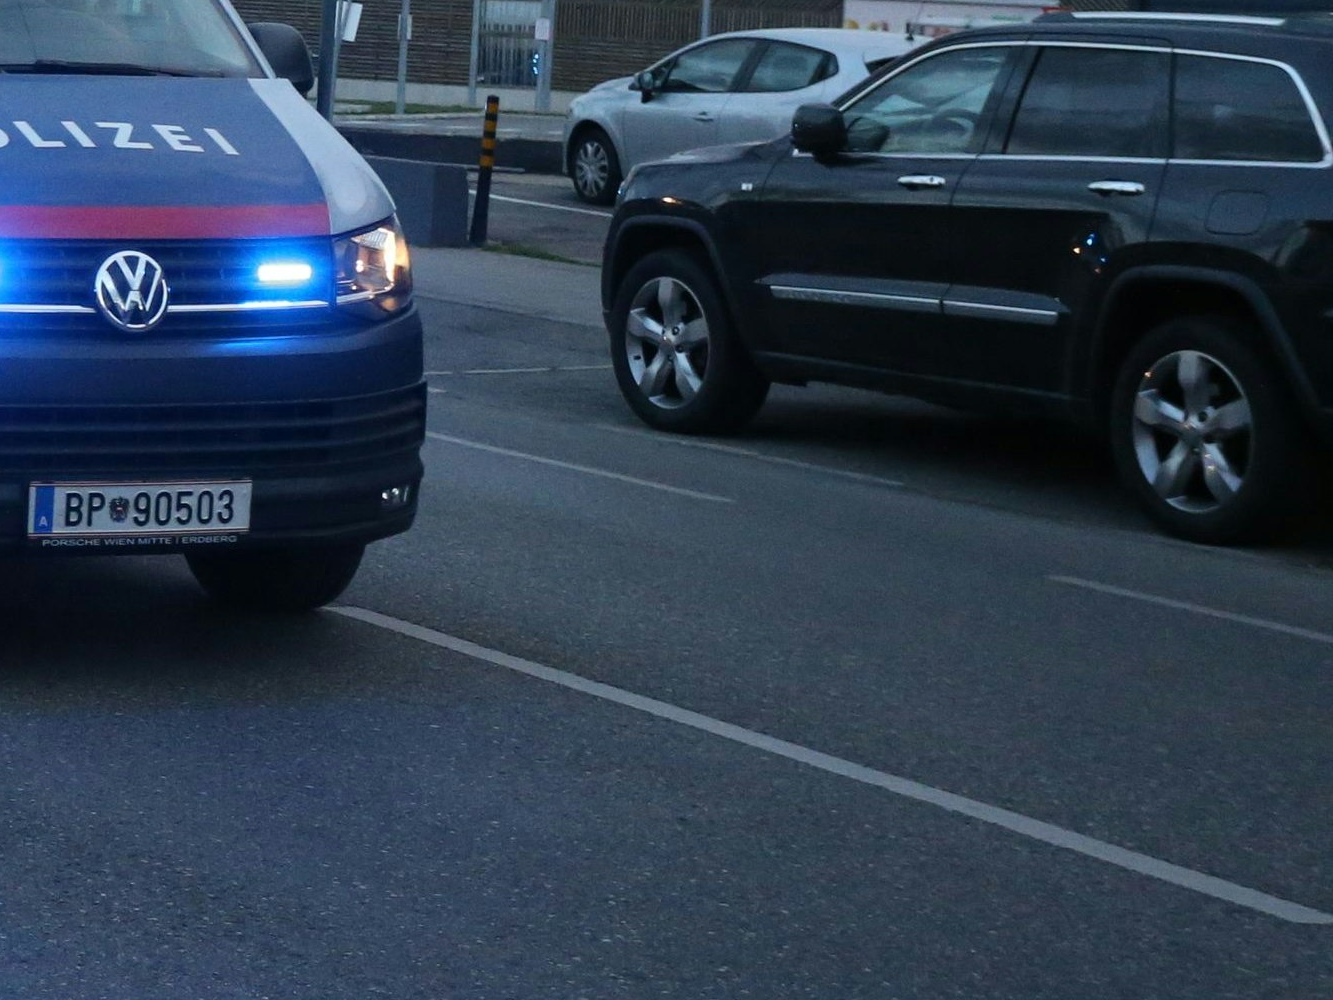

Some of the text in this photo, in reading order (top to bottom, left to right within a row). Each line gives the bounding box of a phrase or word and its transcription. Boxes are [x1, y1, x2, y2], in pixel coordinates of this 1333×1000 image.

[64, 489, 235, 527] BP 90503
[38, 515, 49, 527] A
[42, 535, 238, 547] PORSCHE WIEN MITTE ERDBERG
